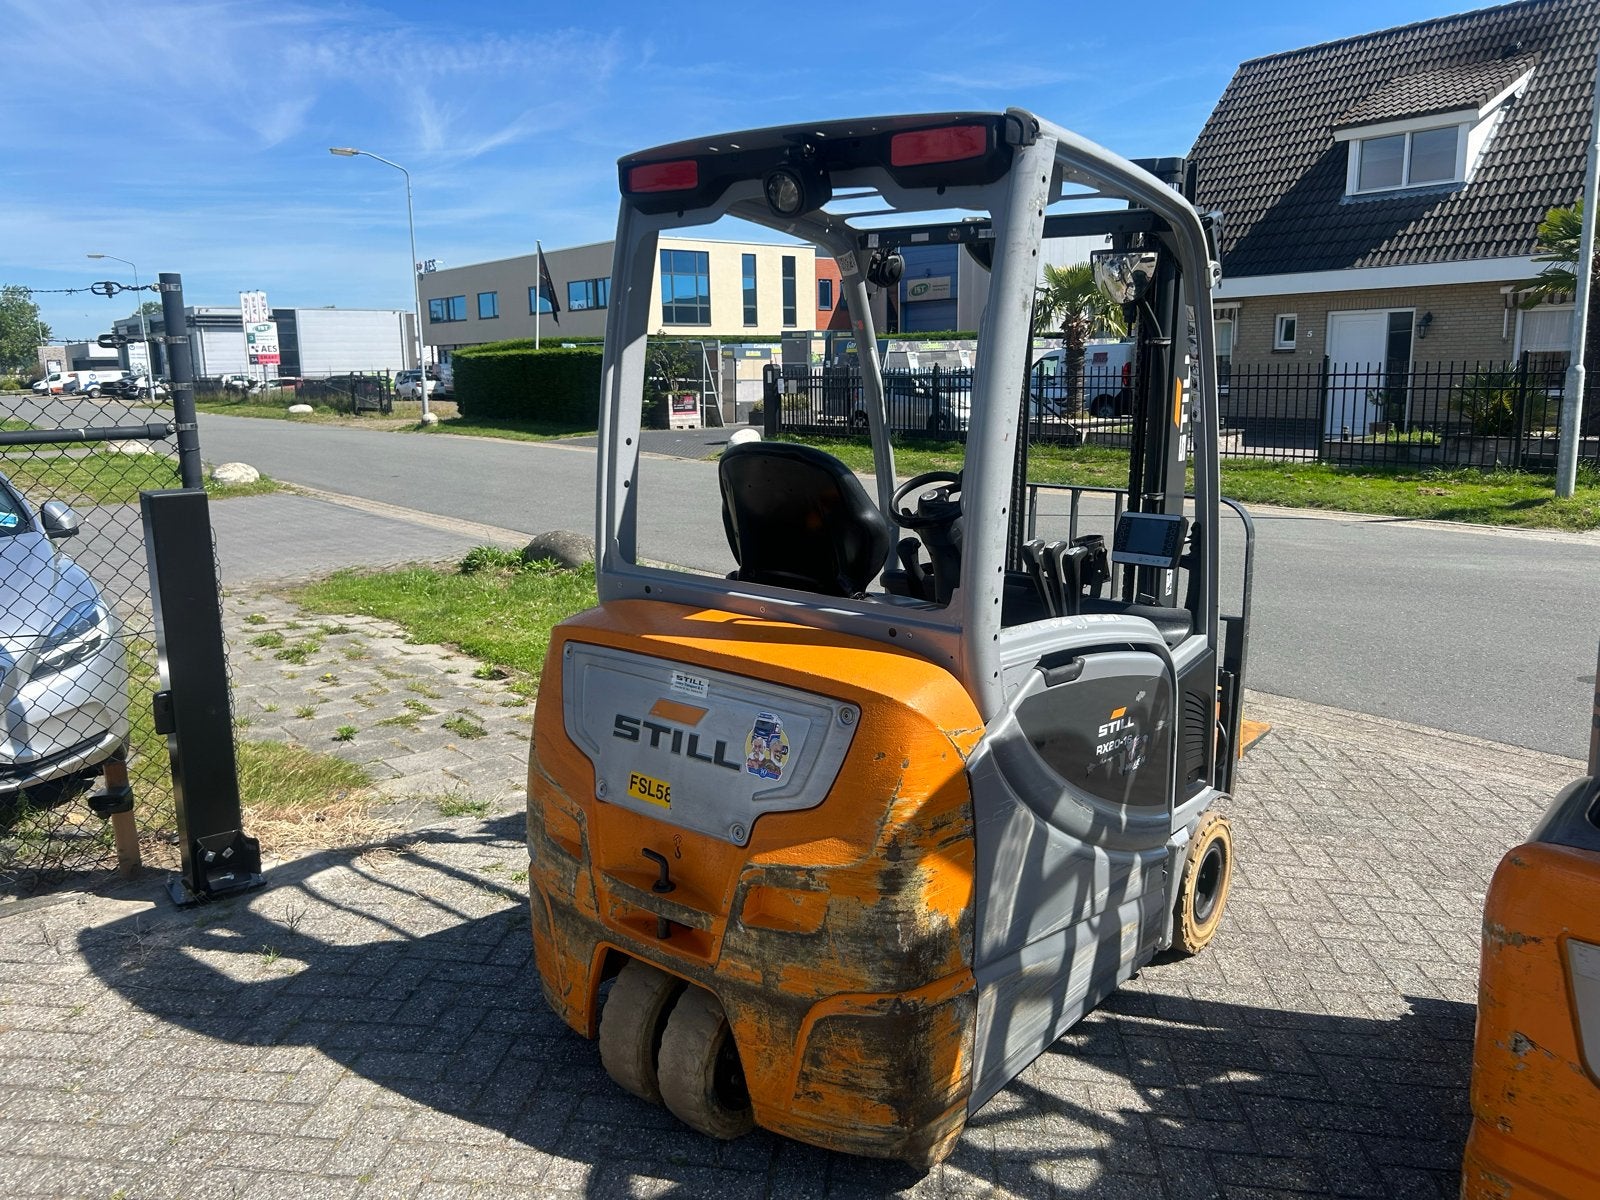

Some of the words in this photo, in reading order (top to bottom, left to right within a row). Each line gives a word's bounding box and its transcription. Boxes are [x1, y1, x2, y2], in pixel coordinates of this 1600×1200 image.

[261, 345, 278, 353] AES
[676, 674, 704, 687] STILL
[1098, 716, 1134, 737] STILL
[612, 713, 741, 772] STILL
